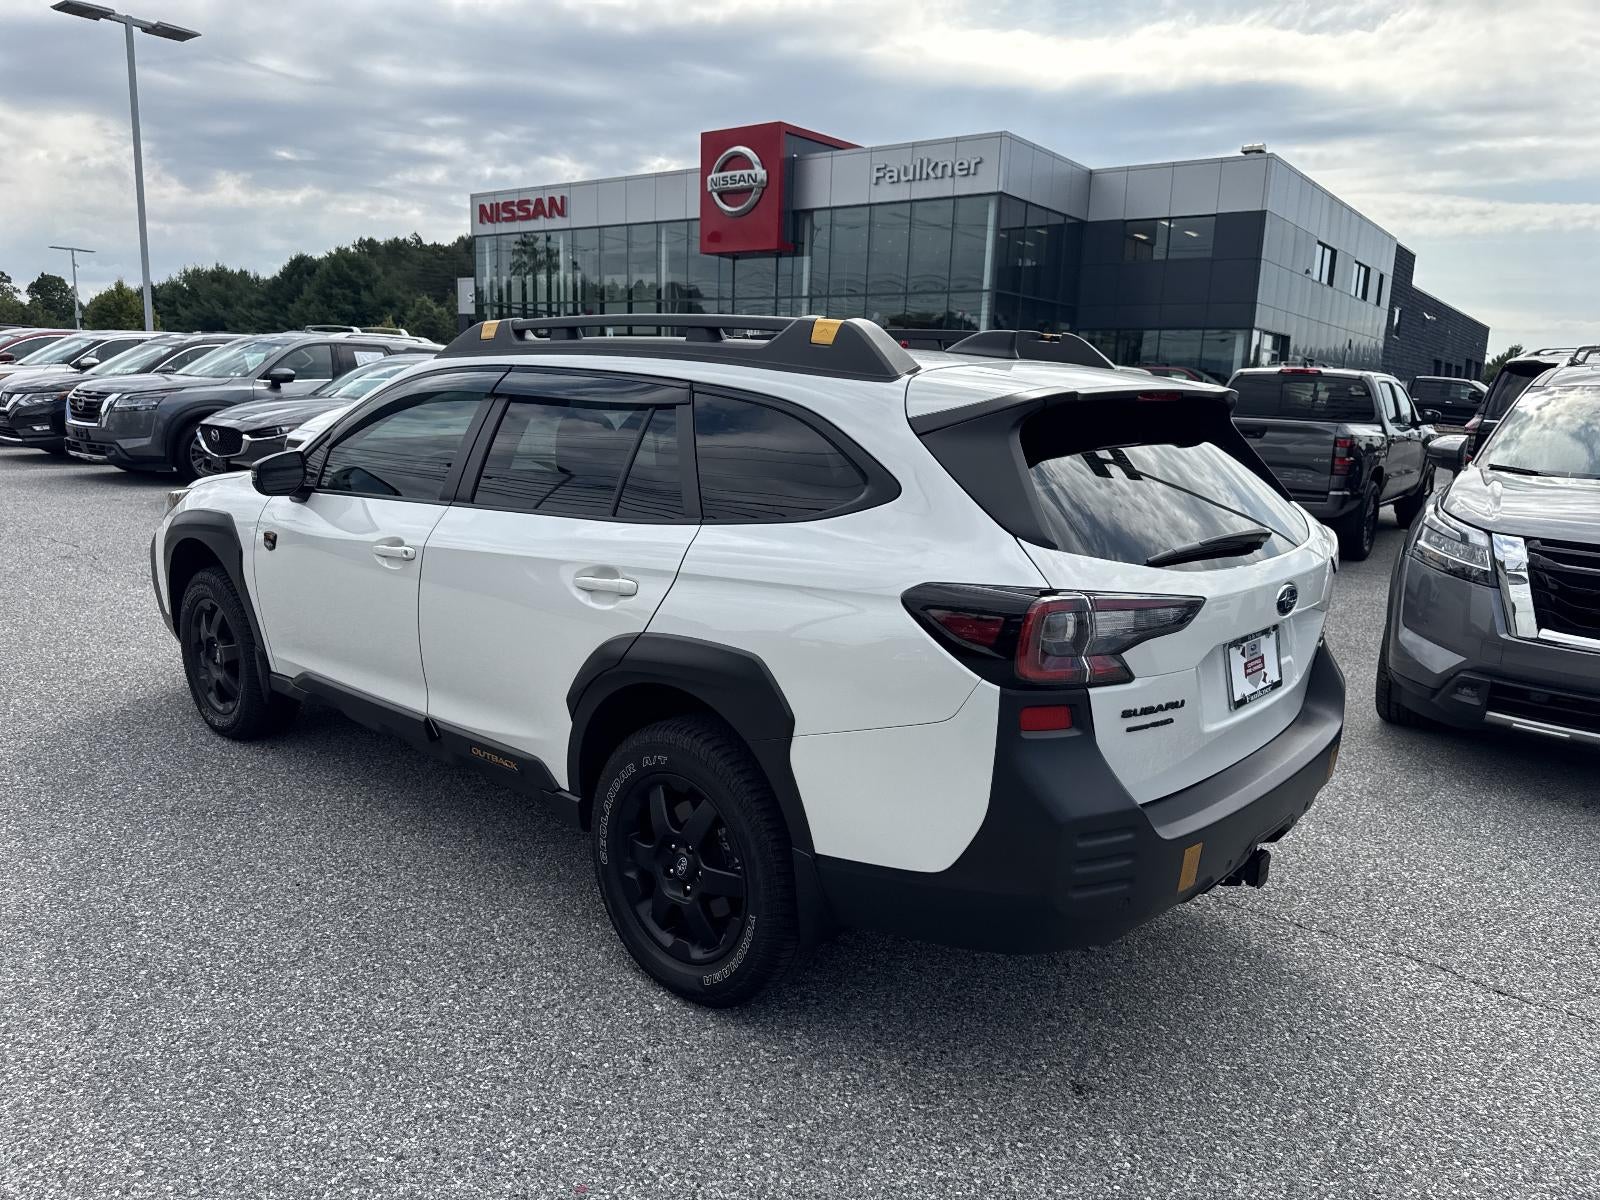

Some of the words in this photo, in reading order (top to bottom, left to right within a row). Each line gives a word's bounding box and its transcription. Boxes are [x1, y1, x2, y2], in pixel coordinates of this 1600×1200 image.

[710, 173, 757, 188] NISSAN
[873, 157, 983, 185] Faulkner
[479, 195, 567, 225] NISSAN
[1121, 699, 1185, 718] SUBARU
[471, 747, 518, 771] OUTBACK
[600, 763, 636, 865] GEOLANDAR
[703, 914, 756, 986] YOKOHAMA
